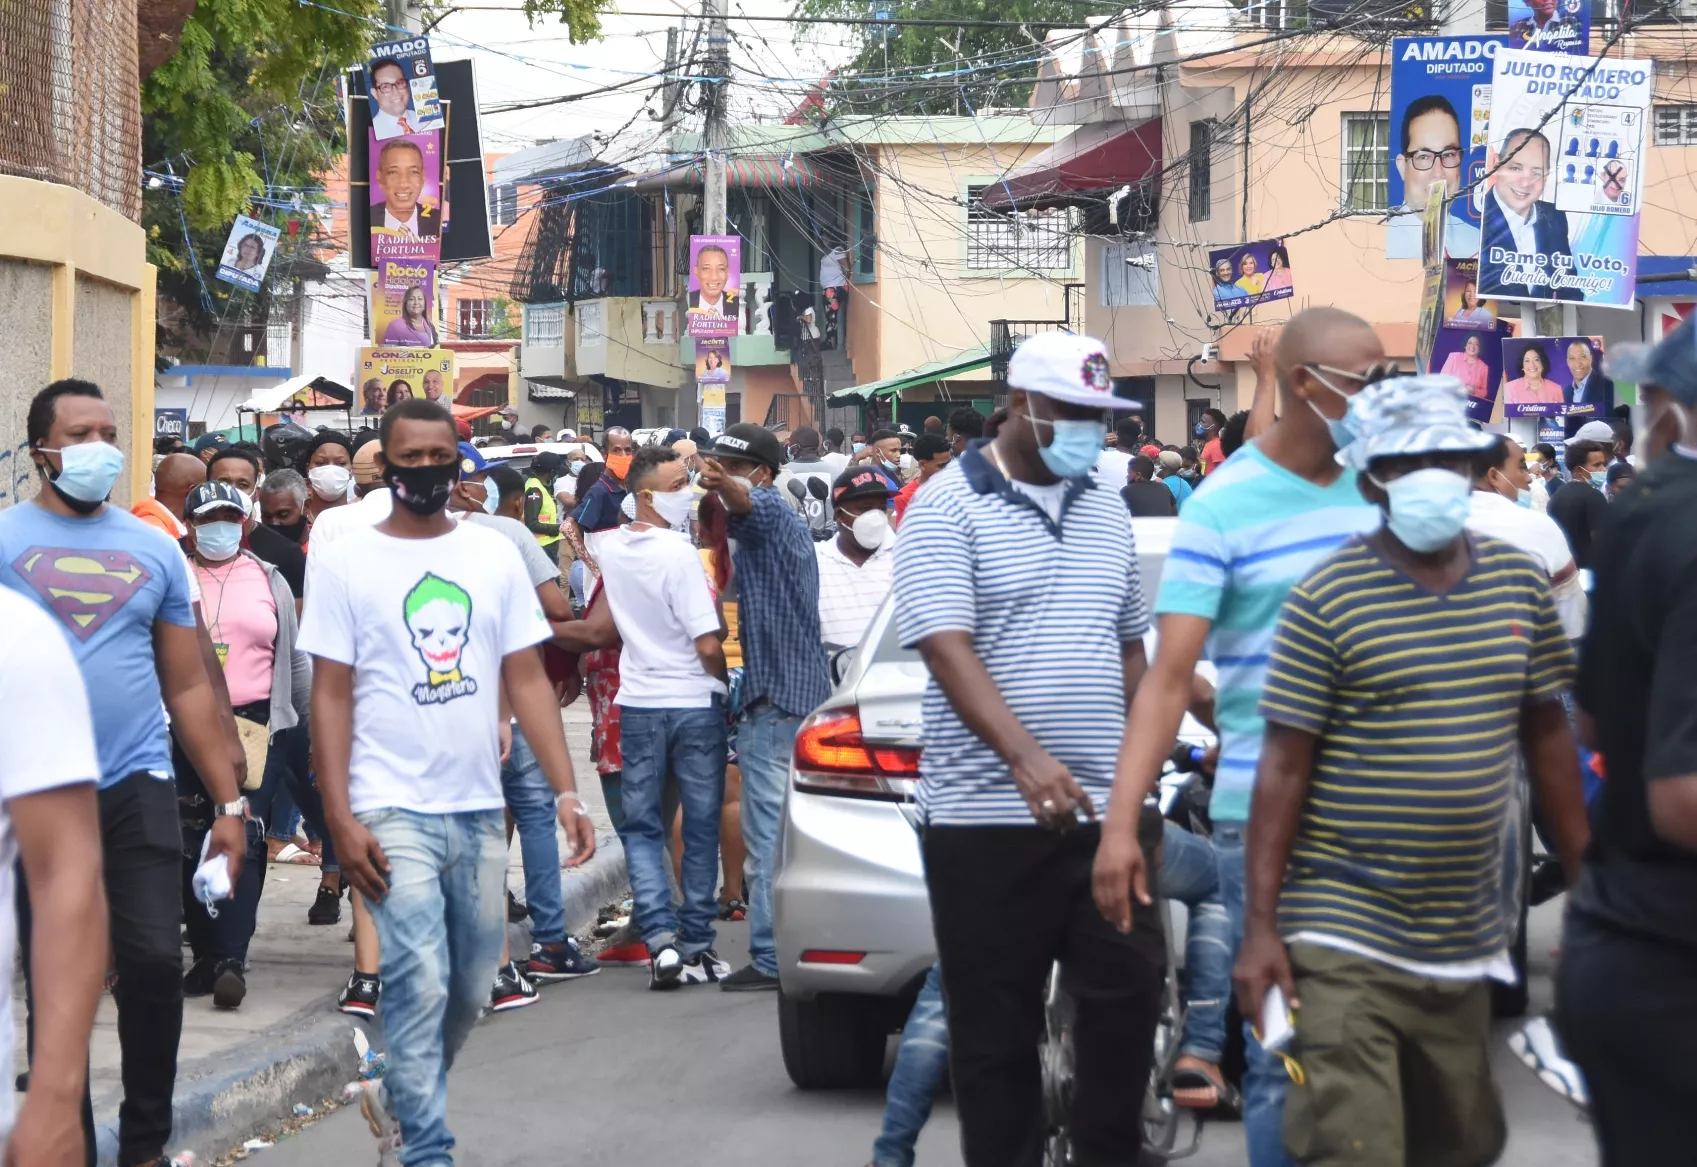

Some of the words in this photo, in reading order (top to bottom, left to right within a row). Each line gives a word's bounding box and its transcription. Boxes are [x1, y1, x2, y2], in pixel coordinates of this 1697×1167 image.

[368, 39, 426, 58] AMADO
[396, 49, 427, 59] DIPUTADO
[1402, 40, 1503, 61] AMADO
[415, 63, 427, 75] 6
[1427, 63, 1484, 74] DIPUTADO
[1500, 61, 1556, 79] JULIO
[1559, 66, 1646, 85] ROMERO
[1526, 80, 1620, 99] DIPUTADO
[1624, 113, 1631, 123] 4
[1621, 192, 1629, 204] 6
[421, 203, 432, 217] 2
[377, 234, 437, 244] RADHAMES
[376, 244, 425, 254] FORTUNA
[1491, 247, 1548, 266] Dame
[1552, 252, 1573, 268] tu
[1579, 254, 1628, 275] Voto,
[385, 276, 421, 287] Hidalgo
[1501, 264, 1549, 286] Cuenta
[1551, 268, 1613, 294] Conmigo!
[726, 292, 734, 303] 2
[371, 351, 432, 359] GONZALO
[200, 482, 233, 502] NY
